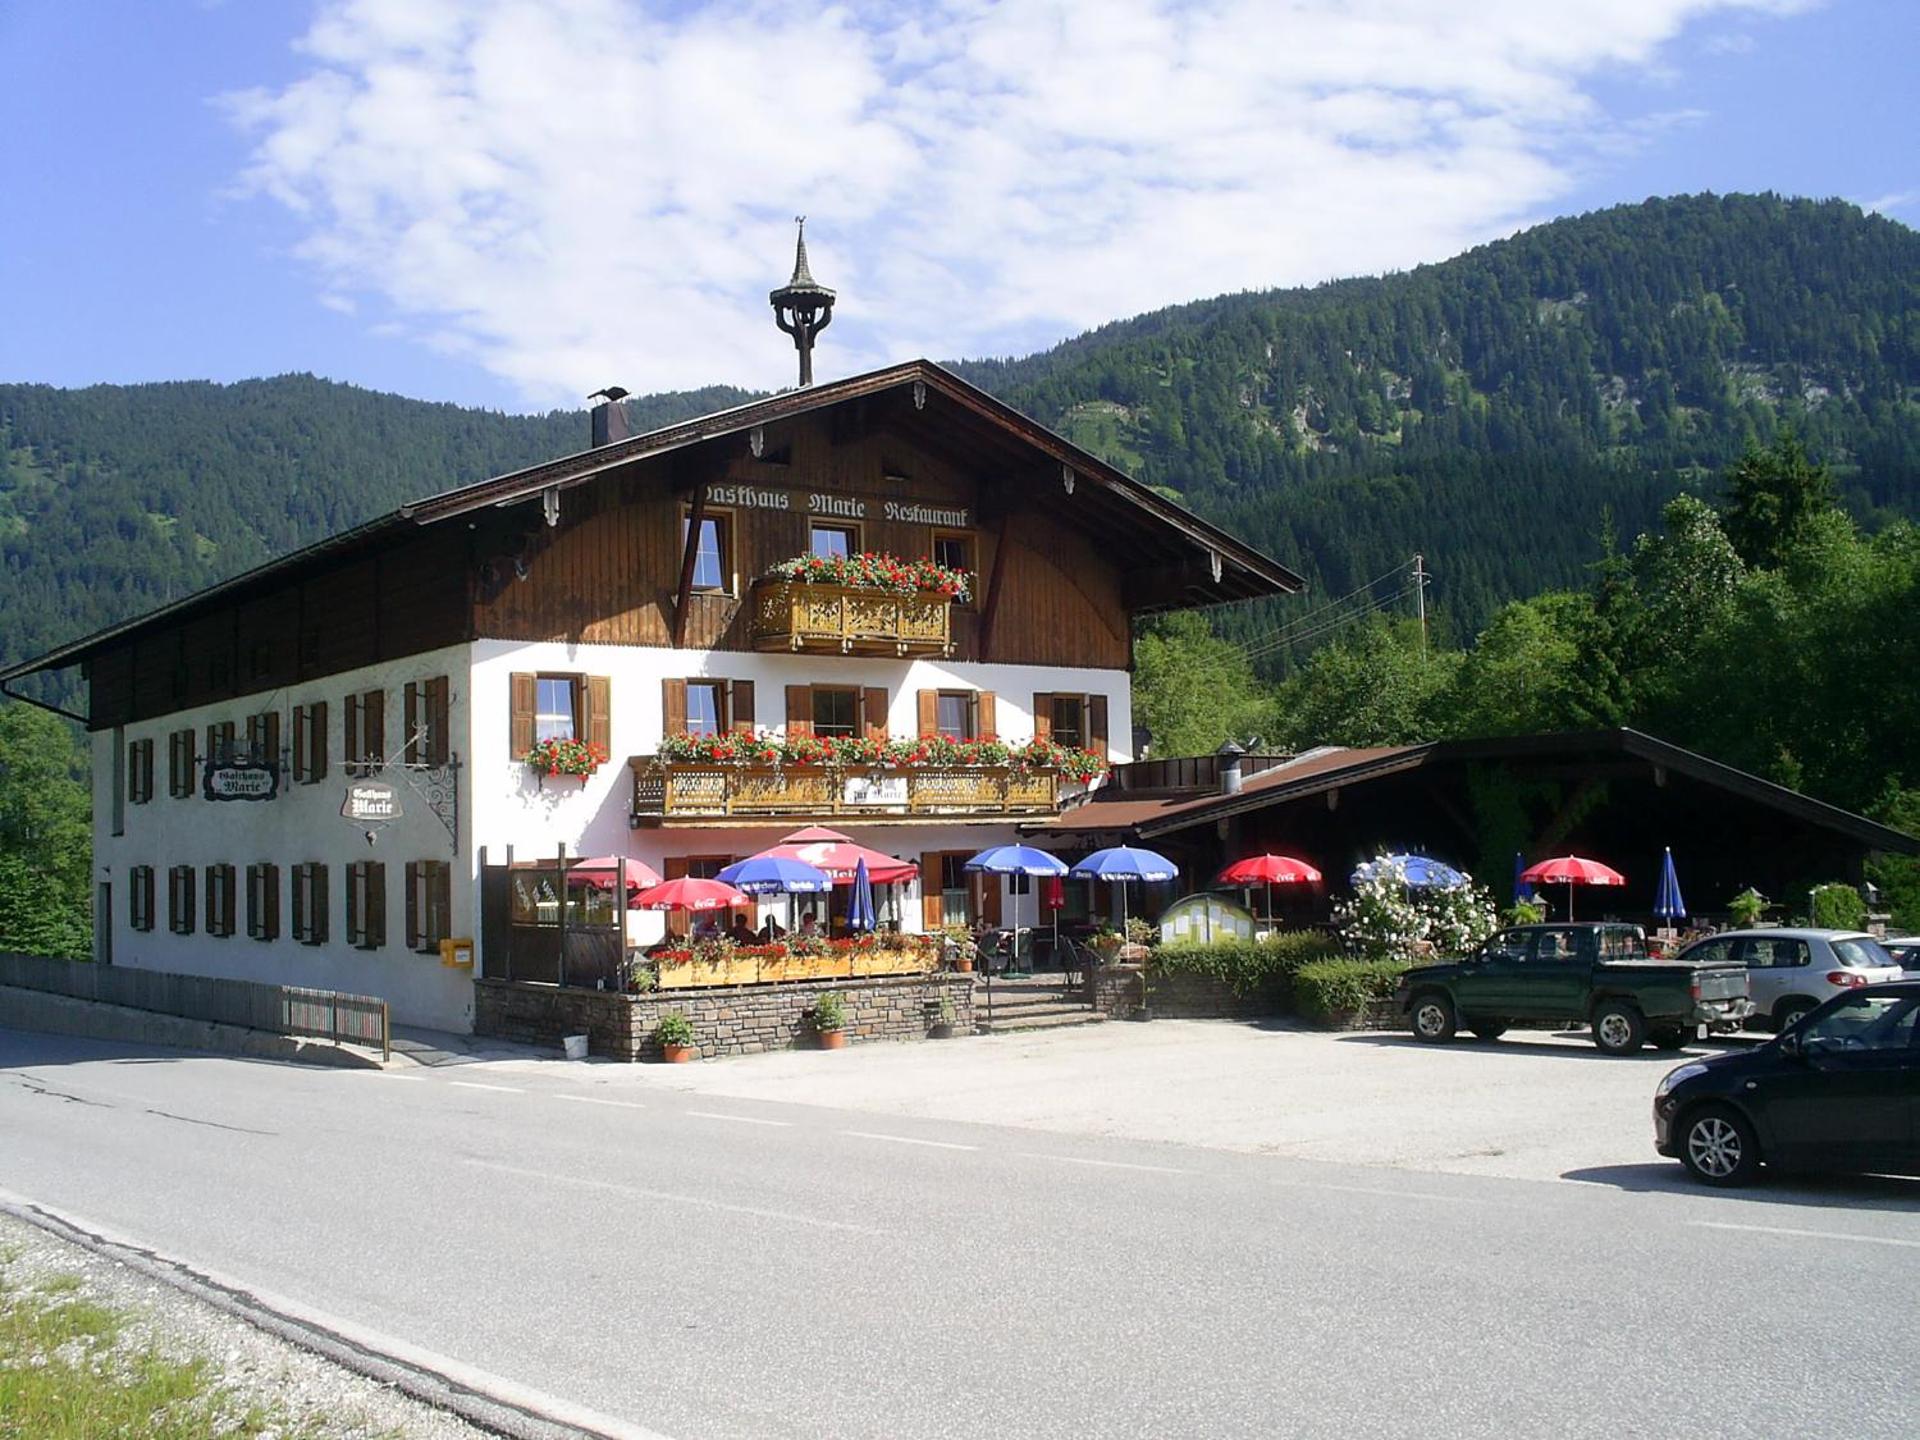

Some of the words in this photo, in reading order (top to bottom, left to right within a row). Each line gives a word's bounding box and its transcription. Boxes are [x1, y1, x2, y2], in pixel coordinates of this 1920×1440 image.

[808, 493, 865, 518] Marie
[884, 501, 968, 527] Restaurant
[352, 799, 392, 816] Marie
